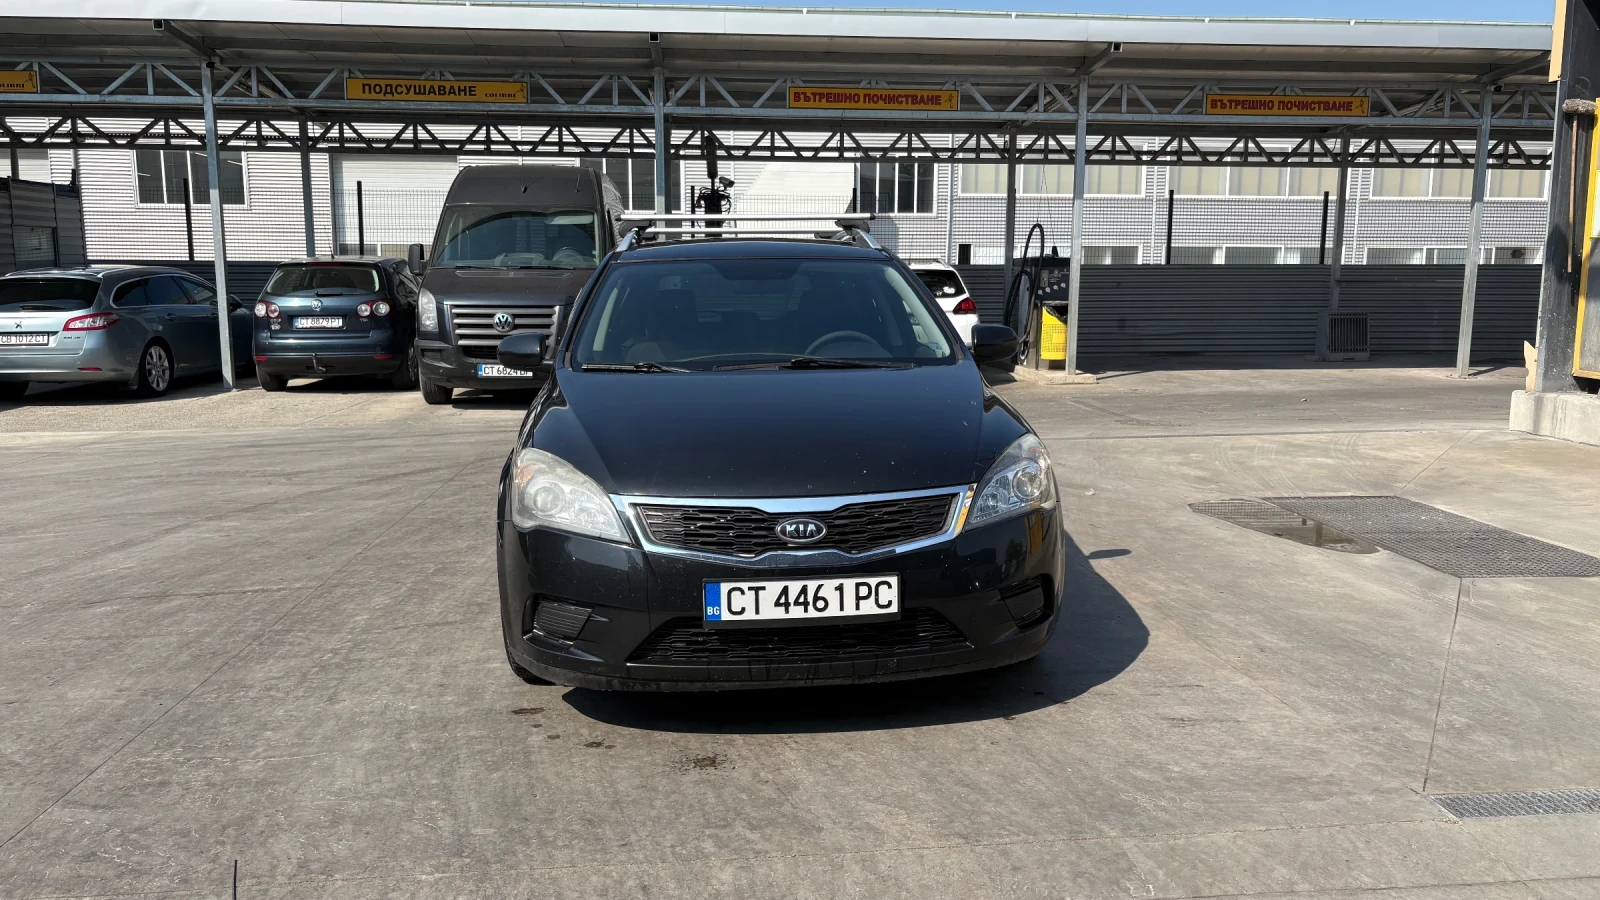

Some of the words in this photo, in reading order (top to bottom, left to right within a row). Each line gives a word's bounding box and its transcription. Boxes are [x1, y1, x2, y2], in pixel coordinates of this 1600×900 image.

[361, 83, 477, 97] ПОДСУШАВАНЕ
[793, 92, 861, 104] ВЪТРЕШНО
[863, 93, 942, 105] ПОЧИСТВАНЕ
[1210, 99, 1274, 110] ВЪТРЕШНО
[1277, 100, 1353, 112] ПОЧИСТВАНЕ
[311, 317, 330, 326] 8879
[14, 334, 34, 343] 1012
[35, 334, 46, 343] CT
[484, 366, 495, 375] CT
[497, 367, 518, 376] 6824
[785, 523, 818, 537] KIA
[707, 606, 720, 615] BG
[727, 586, 766, 616] CT
[773, 583, 844, 614] 4461
[854, 580, 893, 611] PC
